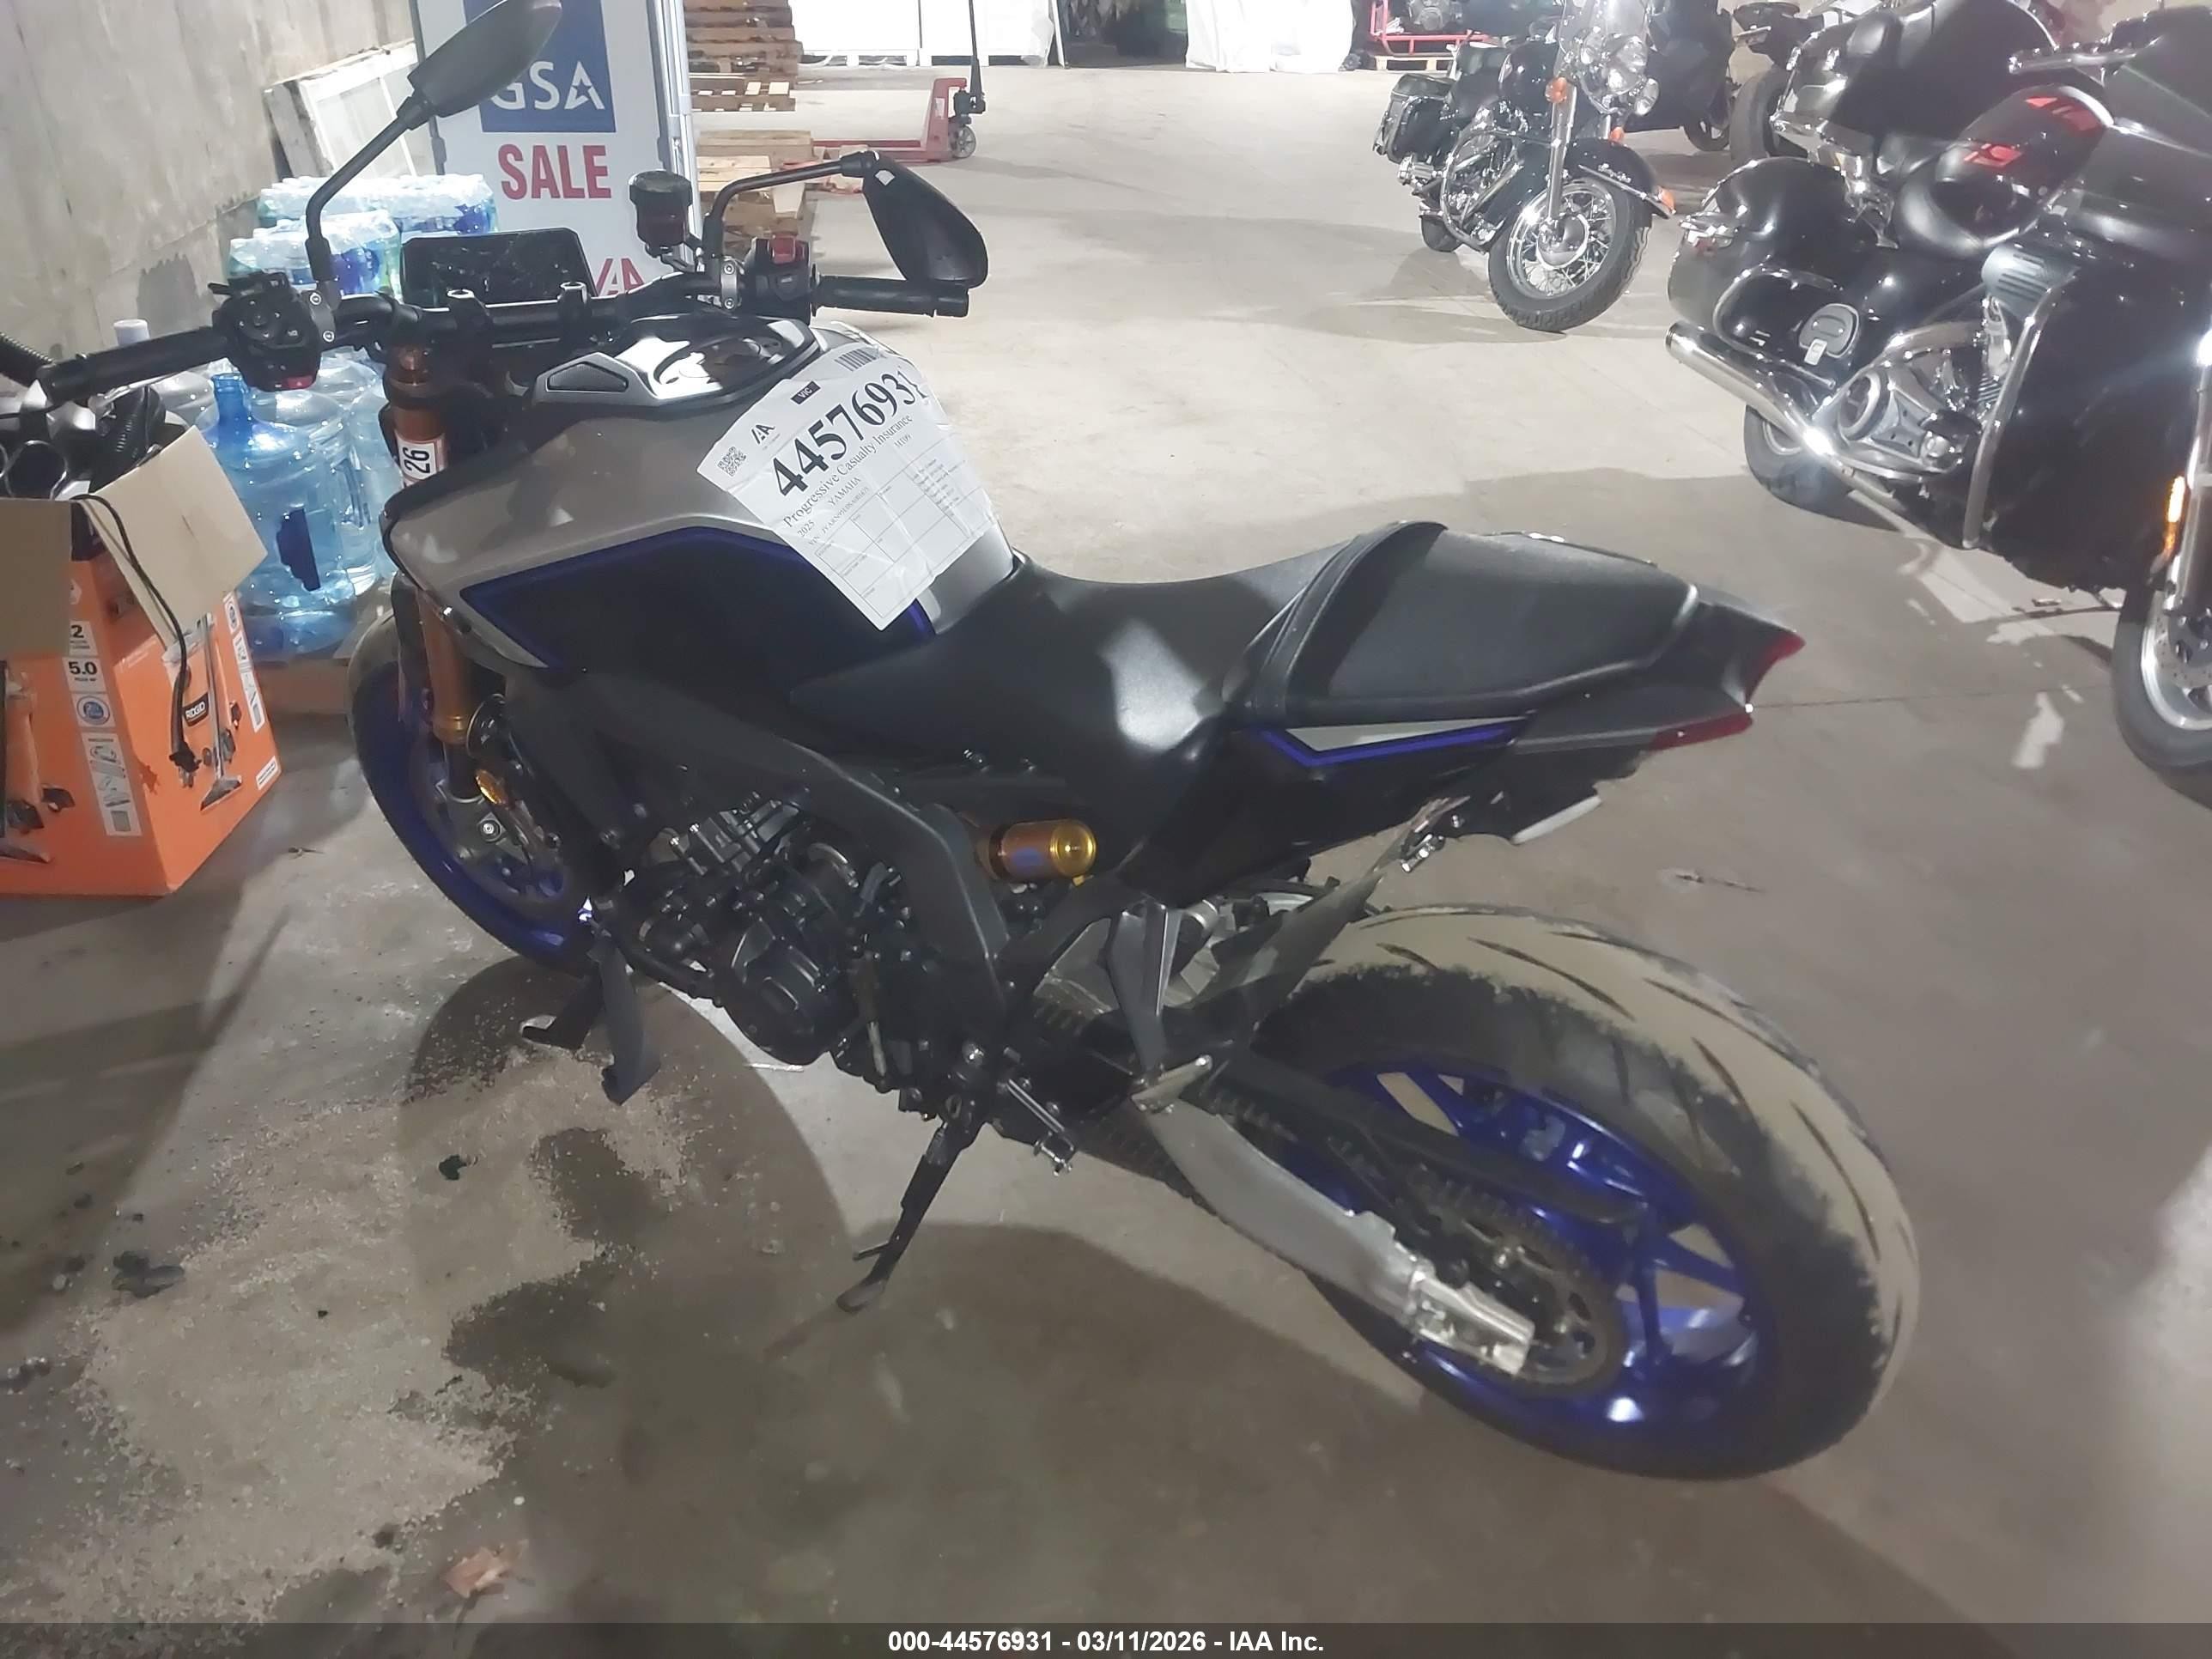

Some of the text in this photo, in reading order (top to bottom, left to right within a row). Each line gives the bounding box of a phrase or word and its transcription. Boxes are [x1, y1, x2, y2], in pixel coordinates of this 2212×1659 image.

[490, 61, 605, 110] GSA
[498, 144, 612, 200] SALE
[798, 387, 813, 399] VIC
[772, 369, 928, 496] 44576931
[402, 447, 430, 473] 26
[782, 473, 840, 527] Progressive
[836, 442, 877, 476] Casualty
[872, 415, 913, 446] Insurance
[797, 520, 815, 538] 2025
[828, 476, 861, 507] YAMAHA
[68, 661, 98, 675] 5.0
